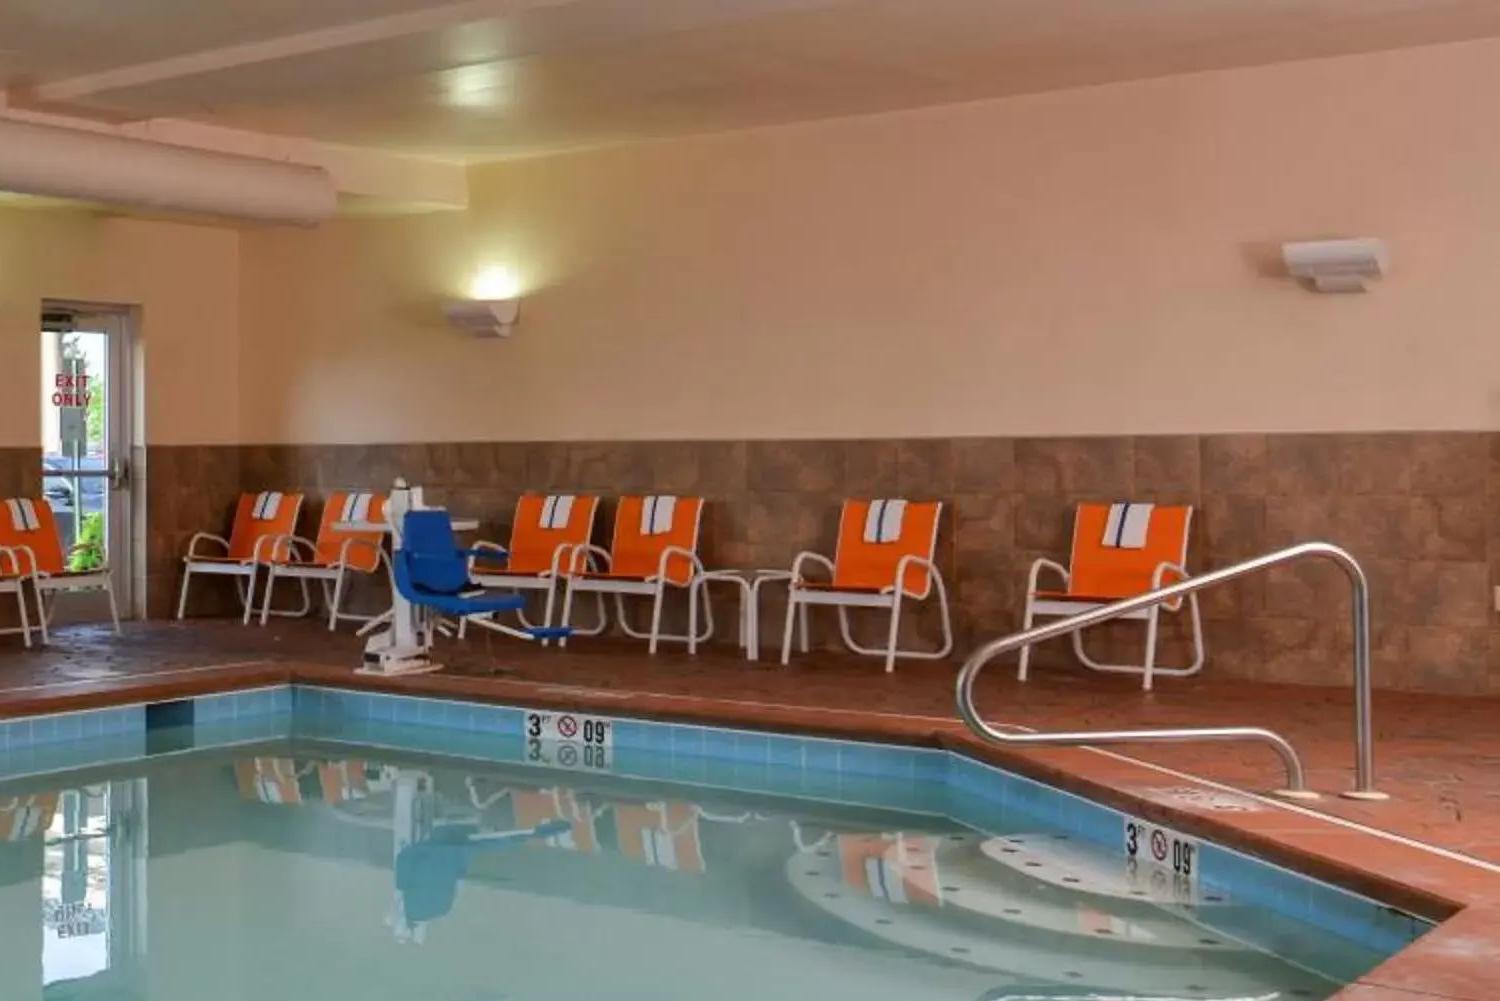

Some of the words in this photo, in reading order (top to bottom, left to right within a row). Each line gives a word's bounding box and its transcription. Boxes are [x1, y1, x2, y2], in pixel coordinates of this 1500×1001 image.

[55, 373, 90, 387] EXIT
[52, 392, 91, 407] ONLY
[528, 713, 541, 737] 3
[583, 719, 605, 744] 09
[1127, 823, 1138, 856] 3
[1173, 840, 1191, 875] 09
